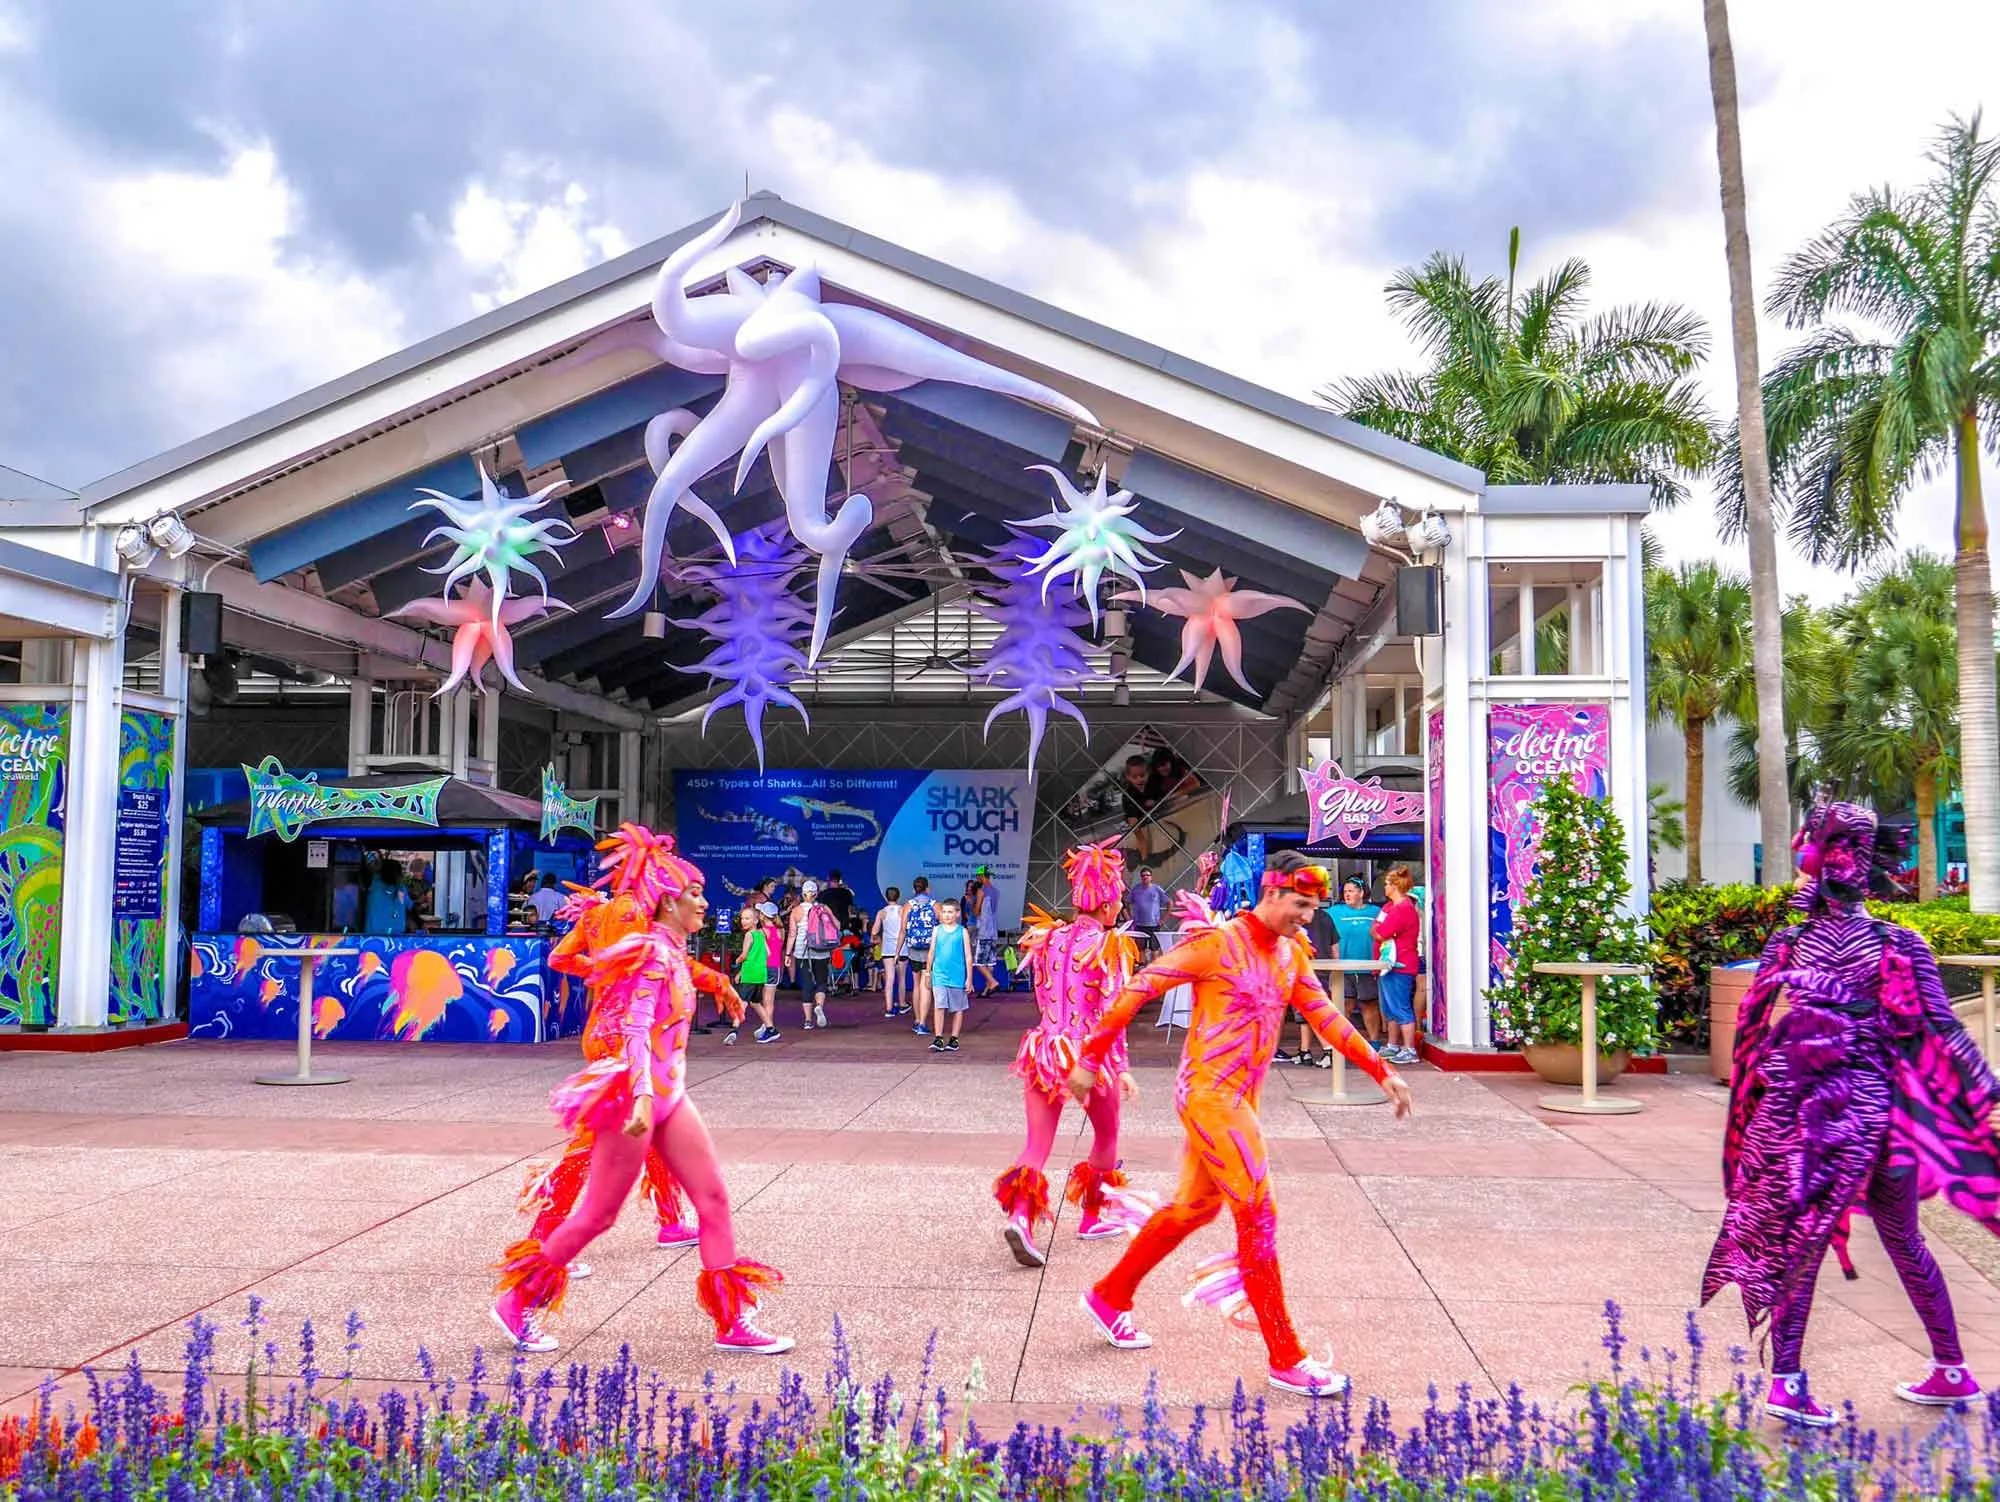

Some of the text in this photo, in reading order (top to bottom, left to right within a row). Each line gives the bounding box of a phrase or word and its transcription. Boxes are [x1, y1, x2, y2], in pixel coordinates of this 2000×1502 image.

[0, 724, 58, 759] ectric
[1505, 723, 1596, 761] electric
[0, 759, 47, 771] CEAN
[1516, 760, 1584, 774] OCEAN
[687, 779, 714, 788] 450+
[719, 779, 750, 790] Types
[752, 779, 764, 788] of
[829, 779, 843, 788] So
[846, 779, 897, 788] Different!
[137, 801, 149, 809] $25
[256, 789, 329, 815] Waffles
[926, 786, 1018, 808] SHARK
[1318, 786, 1389, 825] Glow
[926, 809, 1019, 832] TOUCH
[1343, 813, 1370, 823] BAR
[944, 832, 1000, 856] Pool
